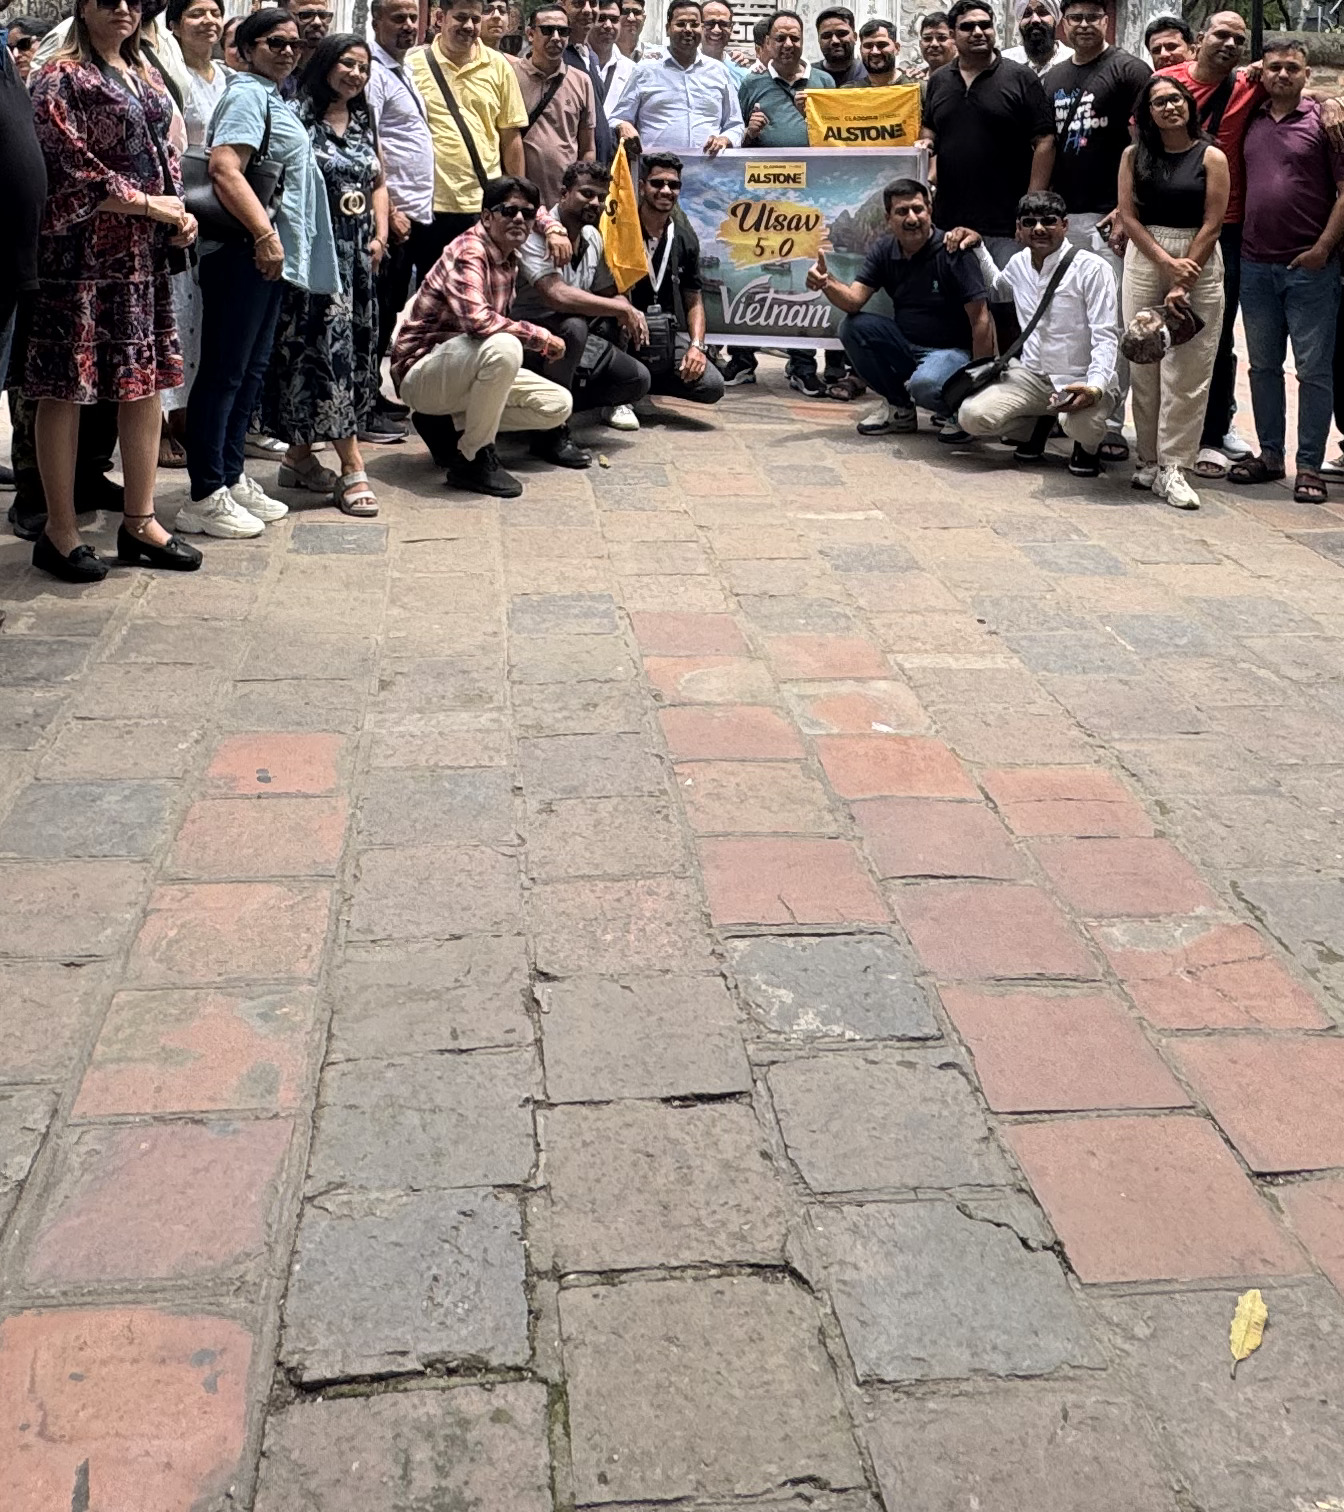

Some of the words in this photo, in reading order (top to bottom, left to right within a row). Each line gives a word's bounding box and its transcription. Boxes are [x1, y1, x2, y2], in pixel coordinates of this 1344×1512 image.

[823, 122, 906, 142] ALSTONE
[747, 172, 802, 185] ALSTONE
[731, 201, 820, 233] Utsav
[754, 237, 794, 258] 5.0
[719, 274, 832, 328] Vietnam
